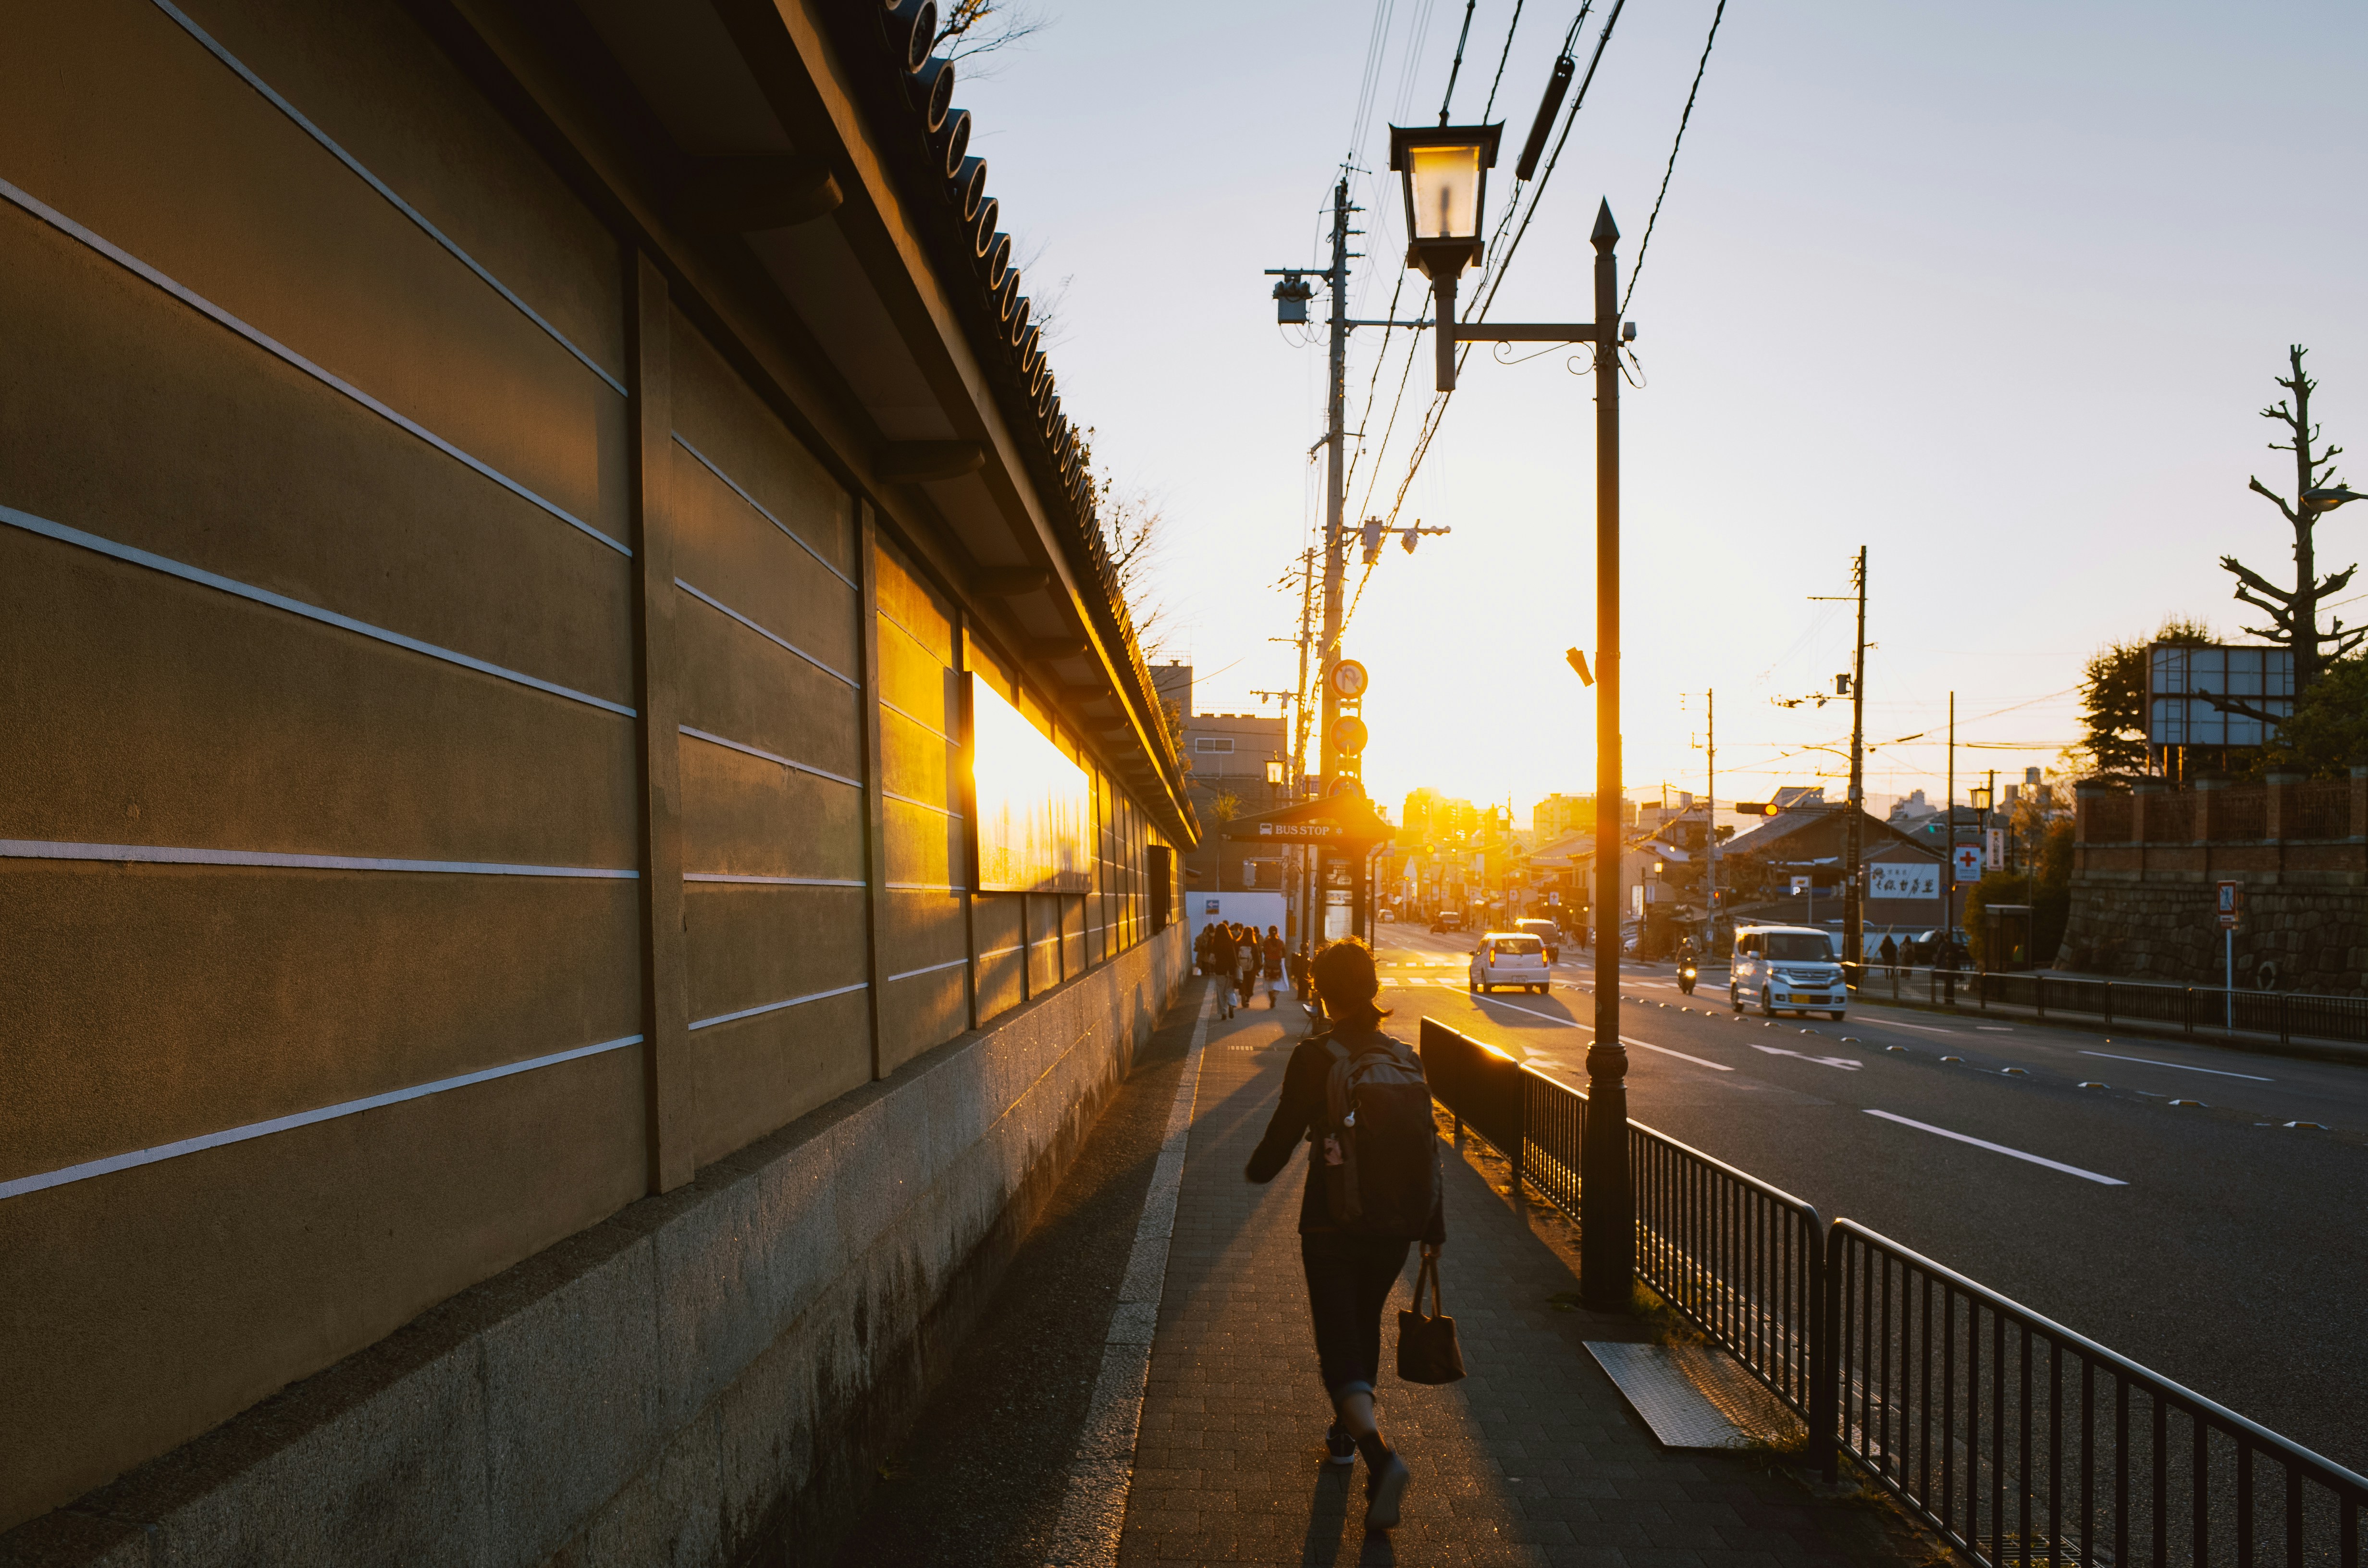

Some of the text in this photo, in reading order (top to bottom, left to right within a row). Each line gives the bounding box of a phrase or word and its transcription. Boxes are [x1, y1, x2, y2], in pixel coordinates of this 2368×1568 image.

[1275, 825, 1330, 835] BUS STOP
[1792, 886, 1801, 895] P
